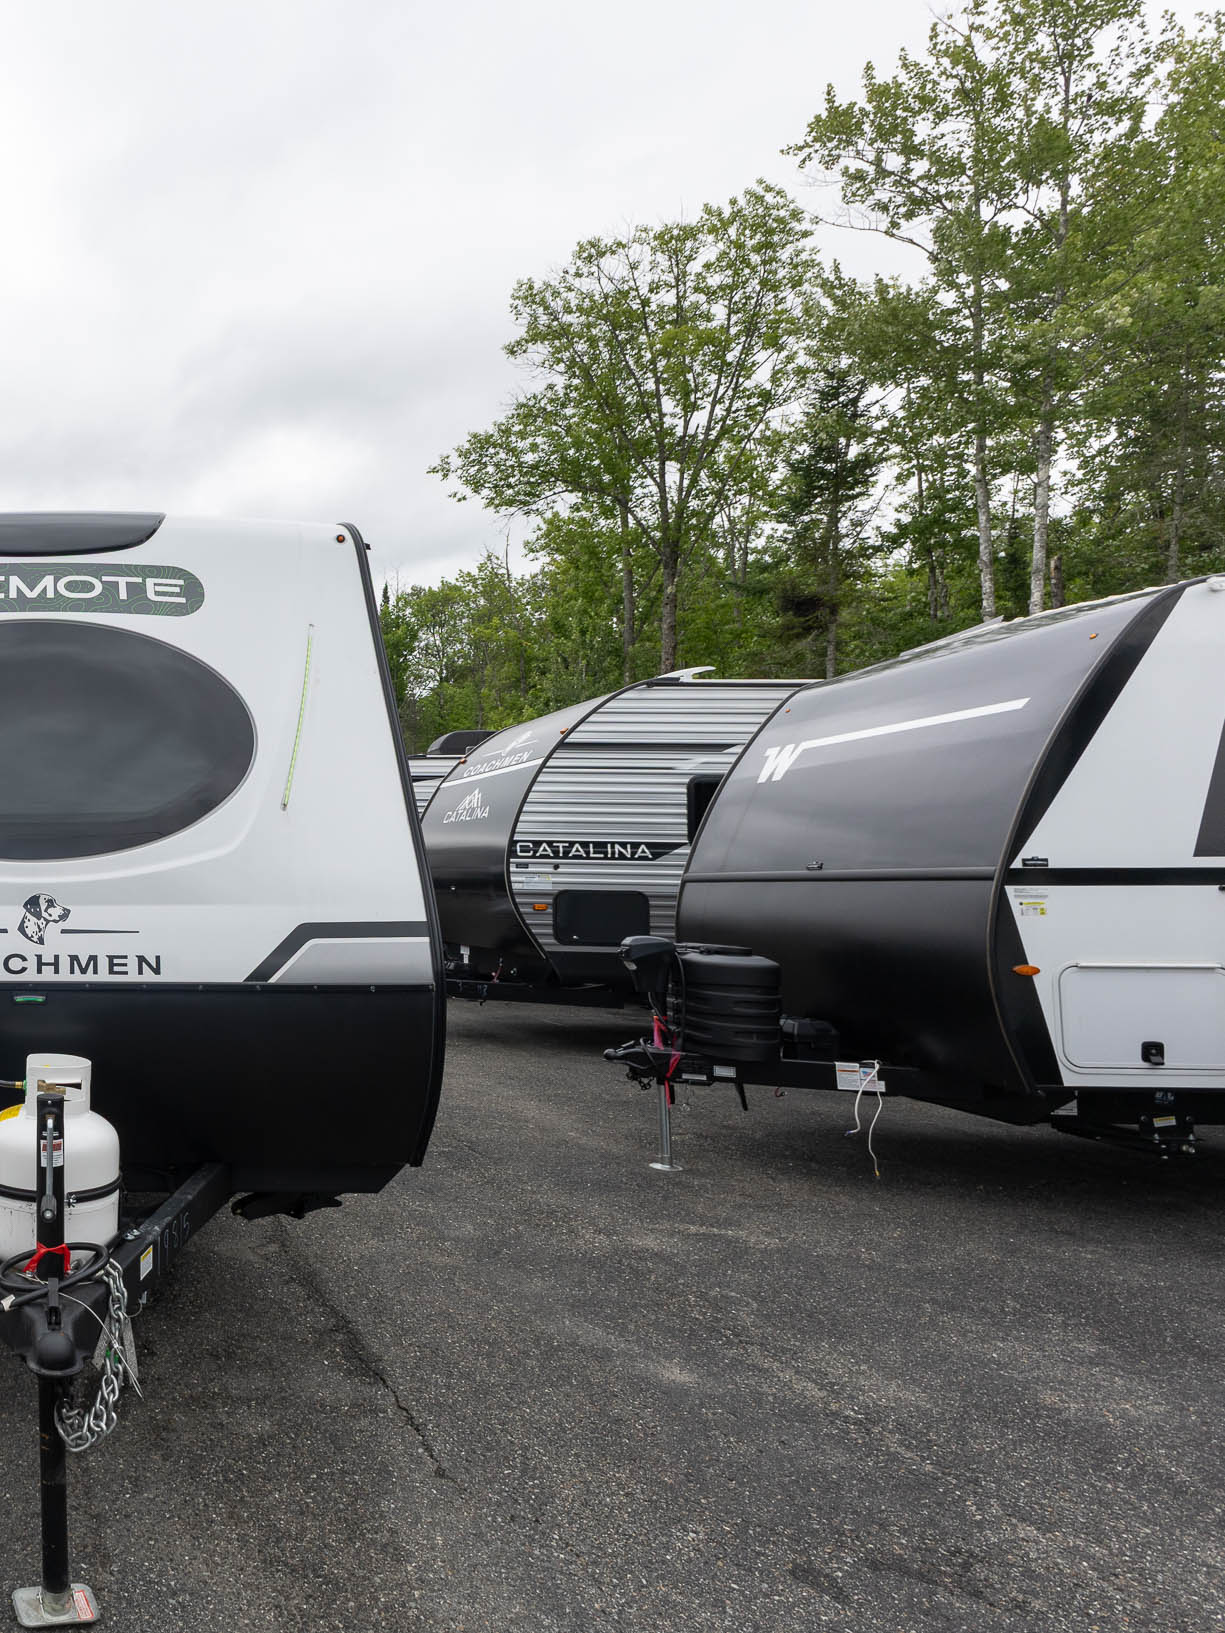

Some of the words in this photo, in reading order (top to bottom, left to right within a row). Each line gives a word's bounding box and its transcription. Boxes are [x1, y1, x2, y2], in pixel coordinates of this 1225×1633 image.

[463, 750, 533, 777] COACHMEN
[443, 805, 489, 823] CATALINA
[516, 842, 653, 859] CATALINA
